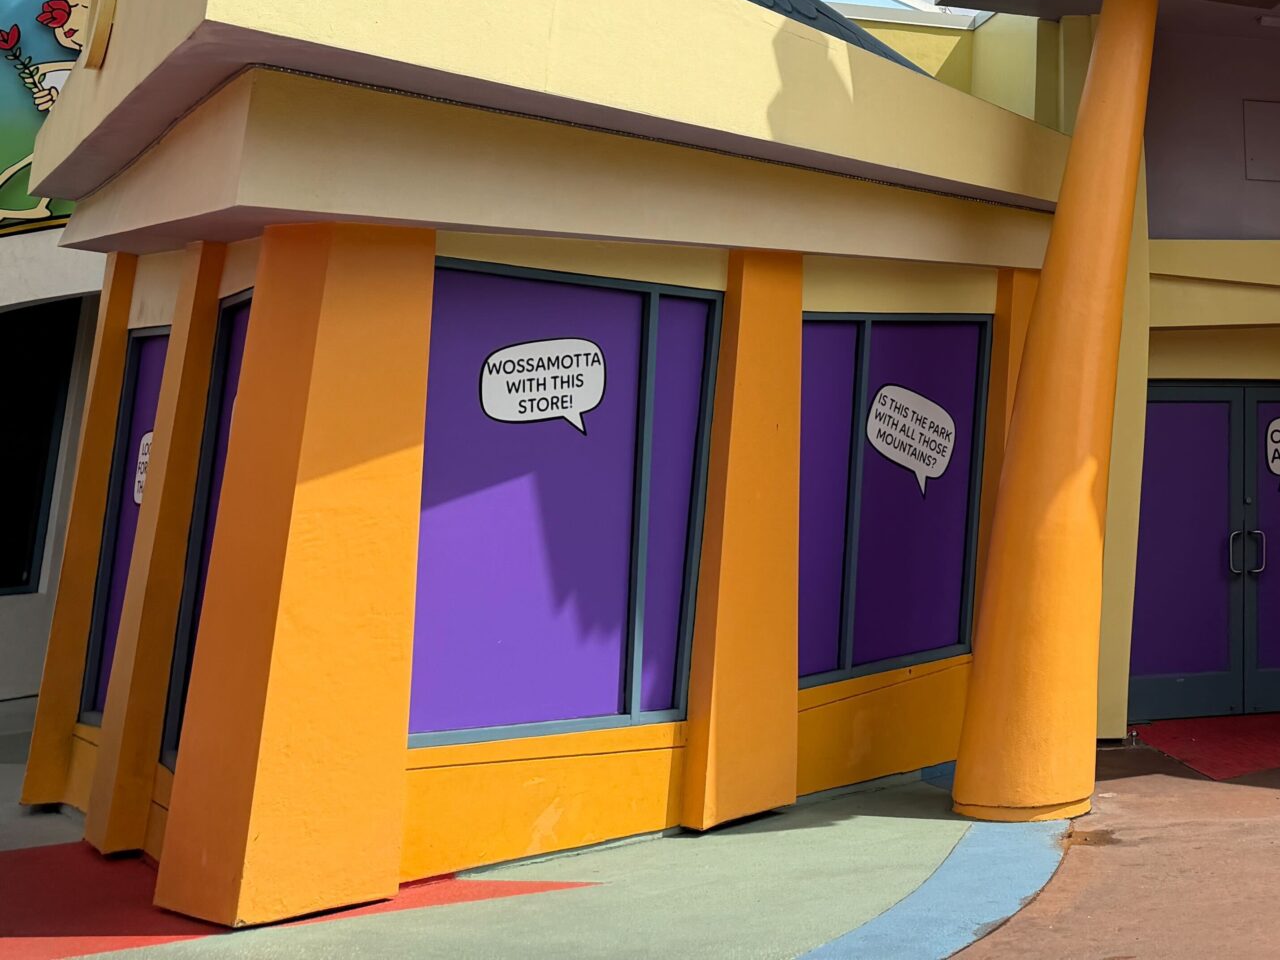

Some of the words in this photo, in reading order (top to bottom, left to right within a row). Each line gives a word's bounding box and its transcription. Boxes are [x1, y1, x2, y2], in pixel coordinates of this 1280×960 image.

[486, 352, 602, 375] WOSSAMOTTA
[506, 377, 547, 394] WITH
[551, 373, 584, 390] THIS
[518, 394, 573, 414] STORE!
[878, 393, 888, 406] IS
[888, 398, 910, 419] THIS
[910, 410, 929, 429] THE
[928, 421, 953, 443] PARK
[874, 408, 900, 431] WITH
[899, 423, 916, 441] ALL
[918, 432, 948, 458] THOSE
[876, 428, 937, 468] MOUNTAINS?
